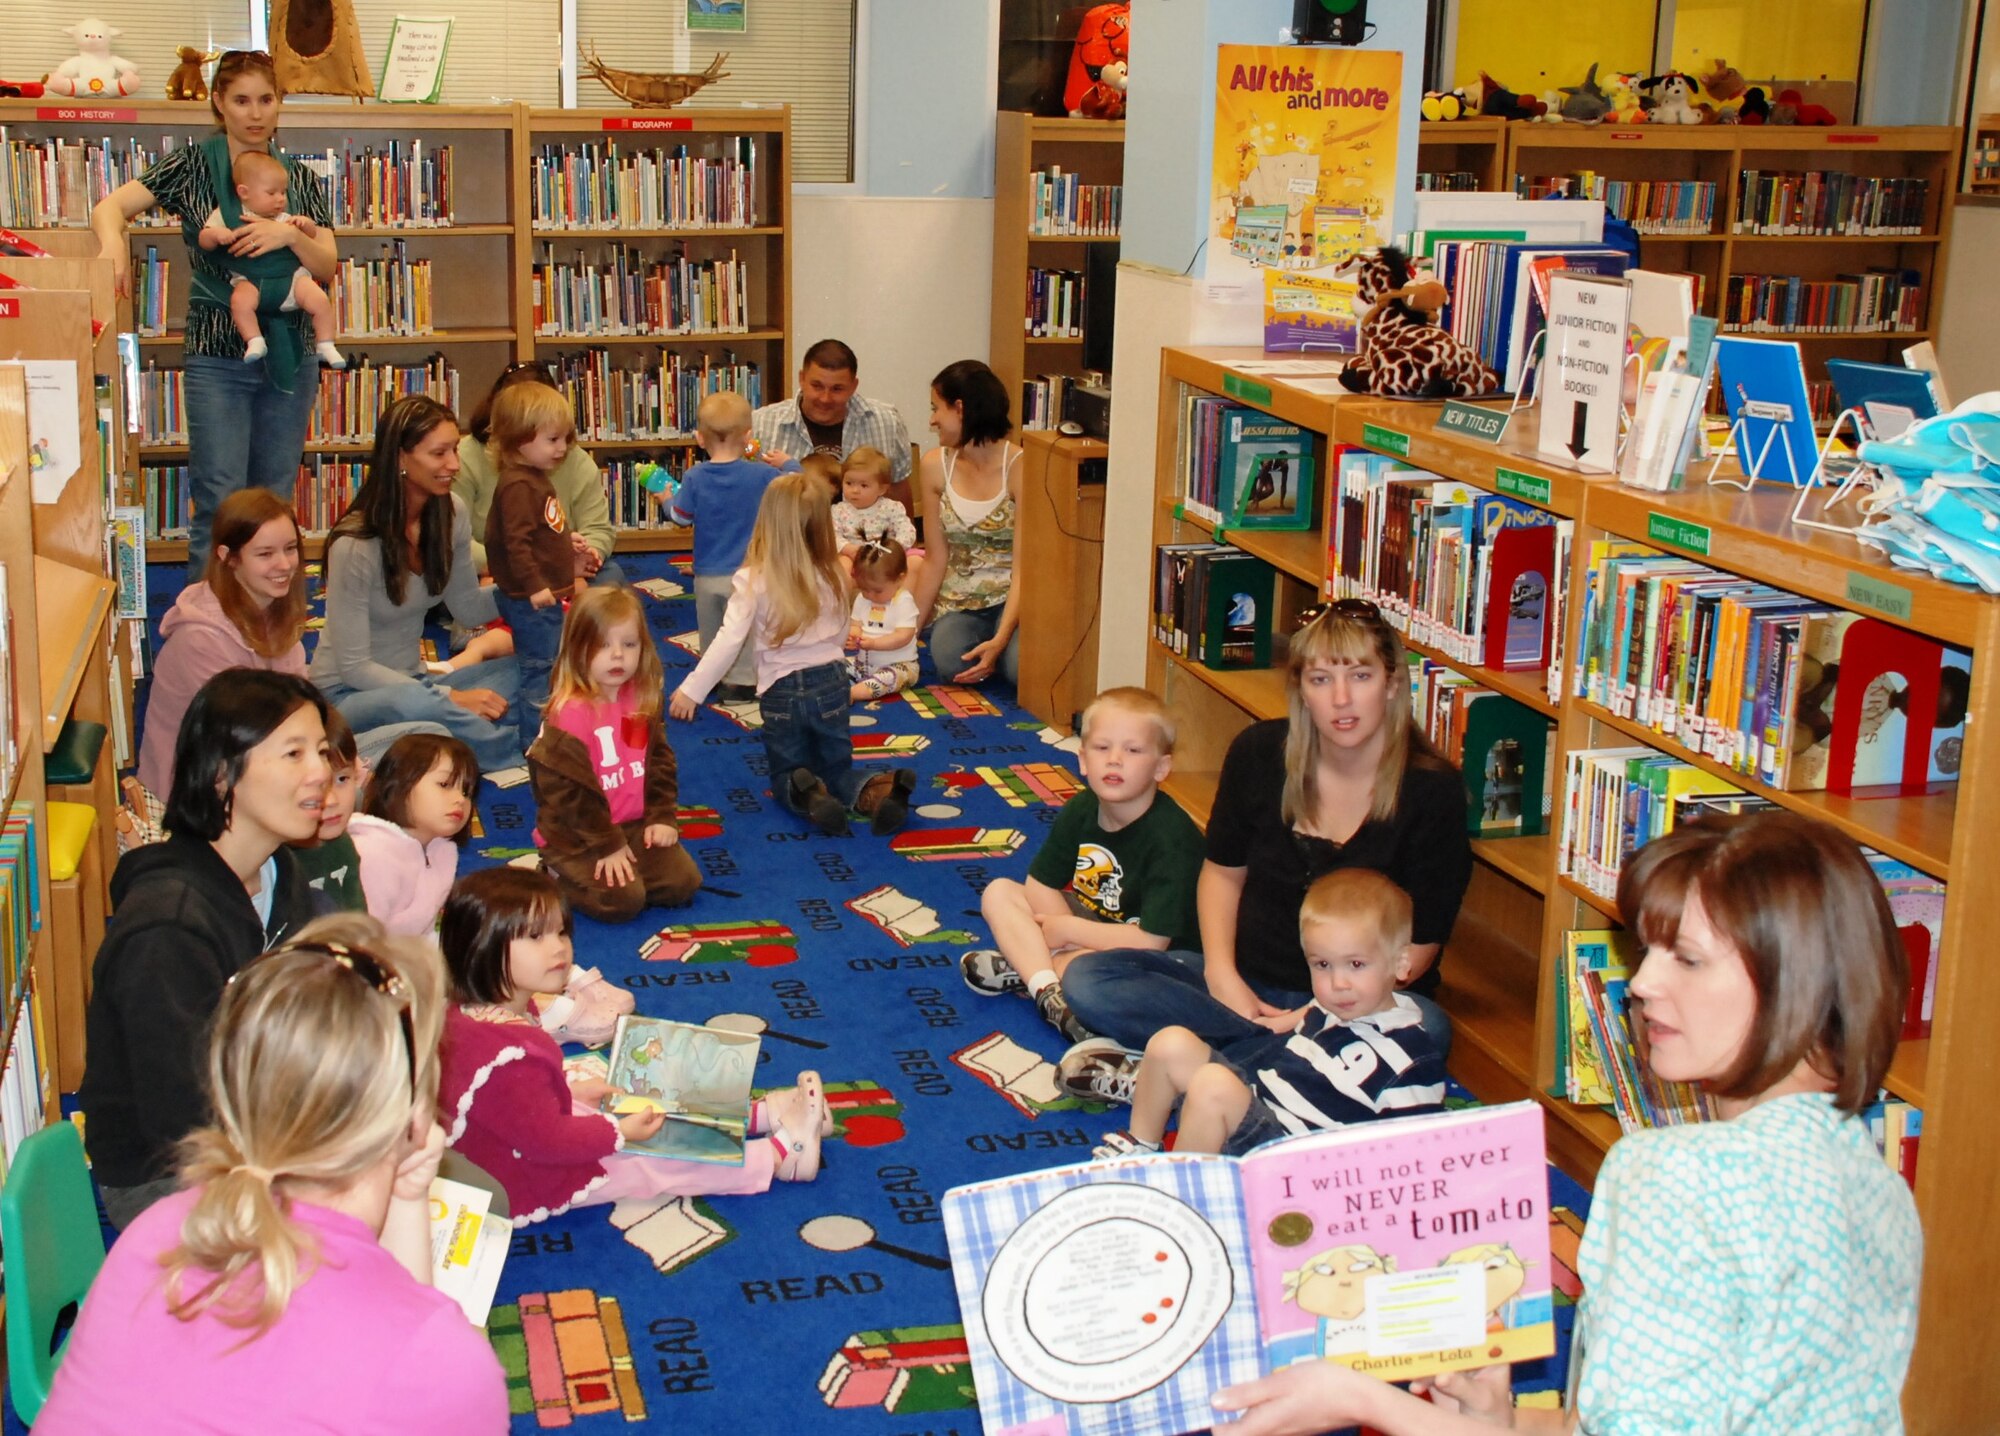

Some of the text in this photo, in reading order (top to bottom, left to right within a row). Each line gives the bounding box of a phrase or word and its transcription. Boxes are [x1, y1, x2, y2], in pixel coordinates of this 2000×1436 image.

[1230, 63, 1315, 94] All this
[1287, 85, 1389, 112] and more
[58, 110, 115, 119] 900 HISTORY
[632, 121, 673, 129] BIOGRAPHY
[1577, 292, 1598, 305] NEW
[1554, 314, 1618, 335] JUNIOR FICTION
[1578, 339, 1591, 348] AND
[1557, 355, 1609, 376] NON-FICTION
[1563, 379, 1598, 397] BOOKS!!
[1443, 409, 1500, 434] NEW TITLES
[1650, 518, 1709, 550] Junior Fiction
[1849, 585, 1907, 615] NEW EASY
[594, 725, 620, 768] I
[813, 852, 856, 882] READ
[797, 898, 843, 932] READ
[847, 954, 952, 972] READ
[624, 969, 731, 988] READ
[771, 979, 825, 1020] READ
[907, 987, 963, 1028] READ
[893, 1049, 953, 1096] READ
[966, 1127, 1091, 1153] READ
[1281, 1145, 1513, 1199] I will not ever
[877, 1165, 943, 1225] READ
[1344, 1179, 1450, 1214] NEVER
[1326, 1197, 1535, 1241] eat a tomato
[508, 1231, 574, 1257] RE
[740, 1271, 885, 1304] READ
[649, 1316, 714, 1394] READ
[1350, 1353, 1414, 1372] Charlie
[1439, 1348, 1473, 1364] Lola
